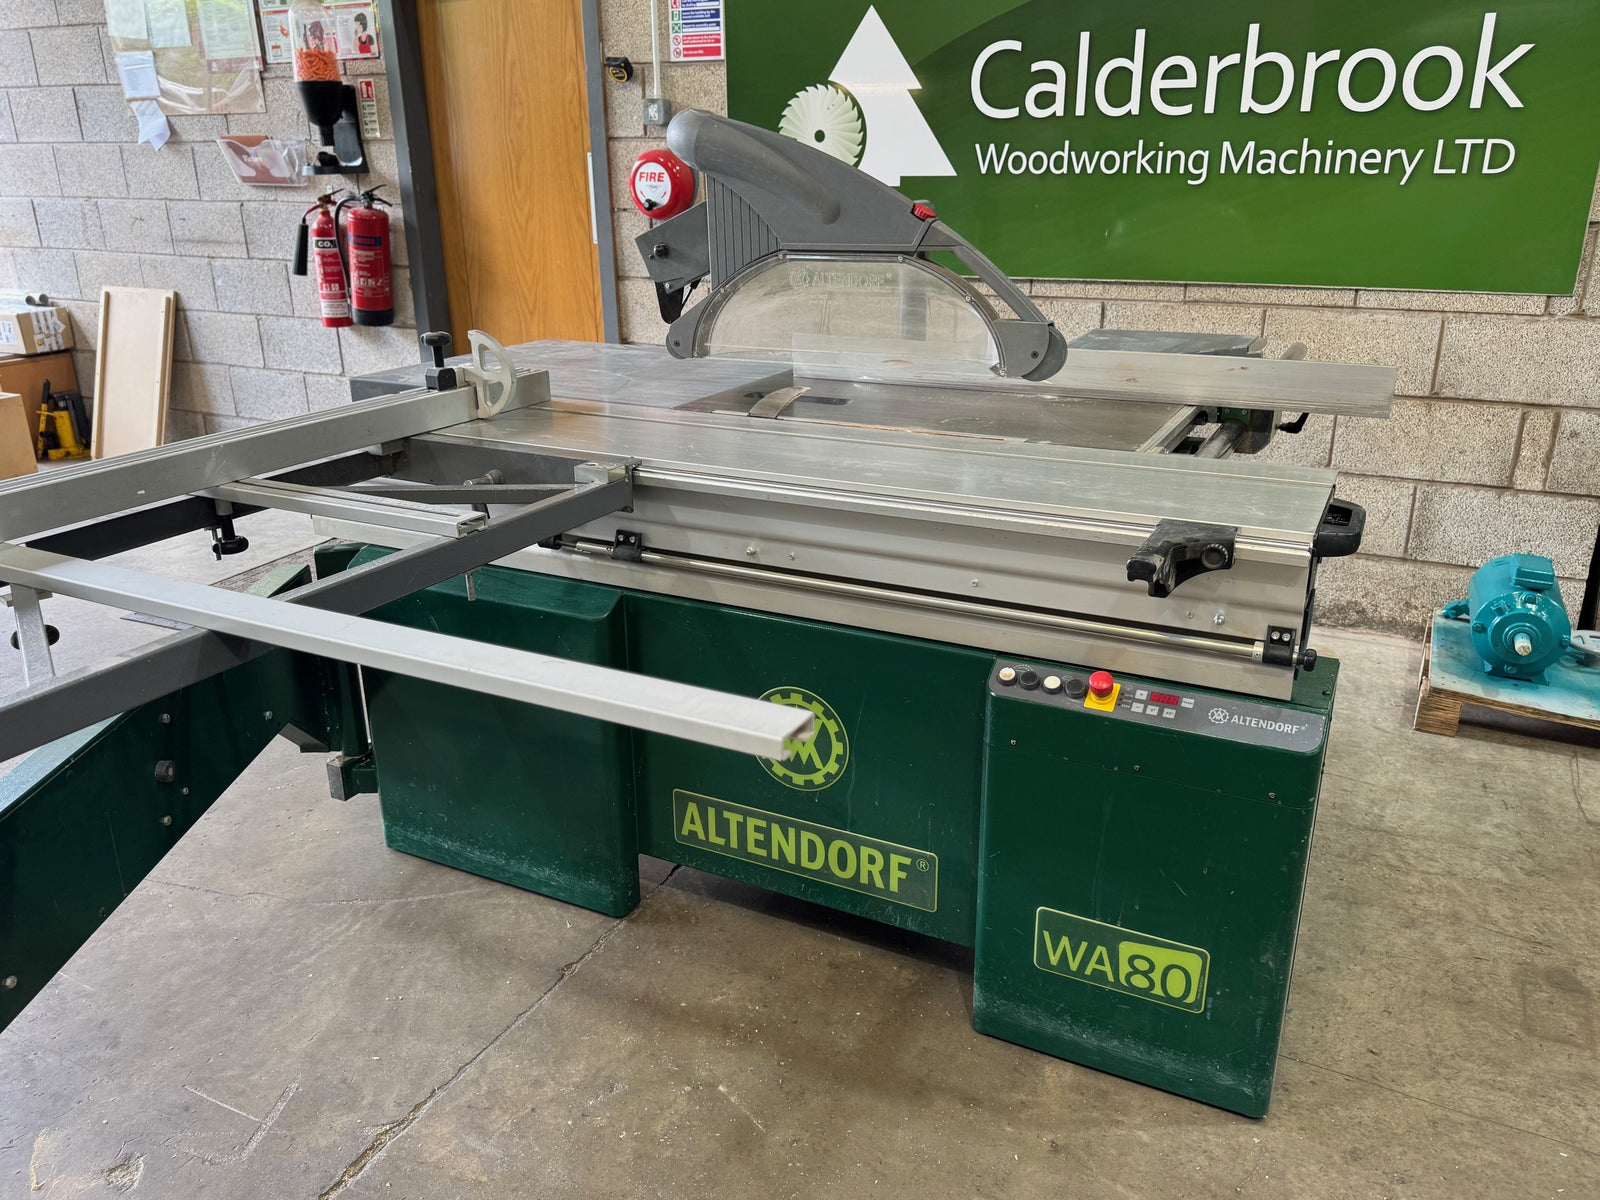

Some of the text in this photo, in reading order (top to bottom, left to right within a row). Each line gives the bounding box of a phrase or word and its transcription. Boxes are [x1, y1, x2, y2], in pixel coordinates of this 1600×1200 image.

[970, 12, 1536, 119] Calderbrook
[638, 171, 665, 183] FIRE
[976, 138, 1516, 186] Woodworking Machinery LTD
[1042, 930, 1193, 1003] WA80
